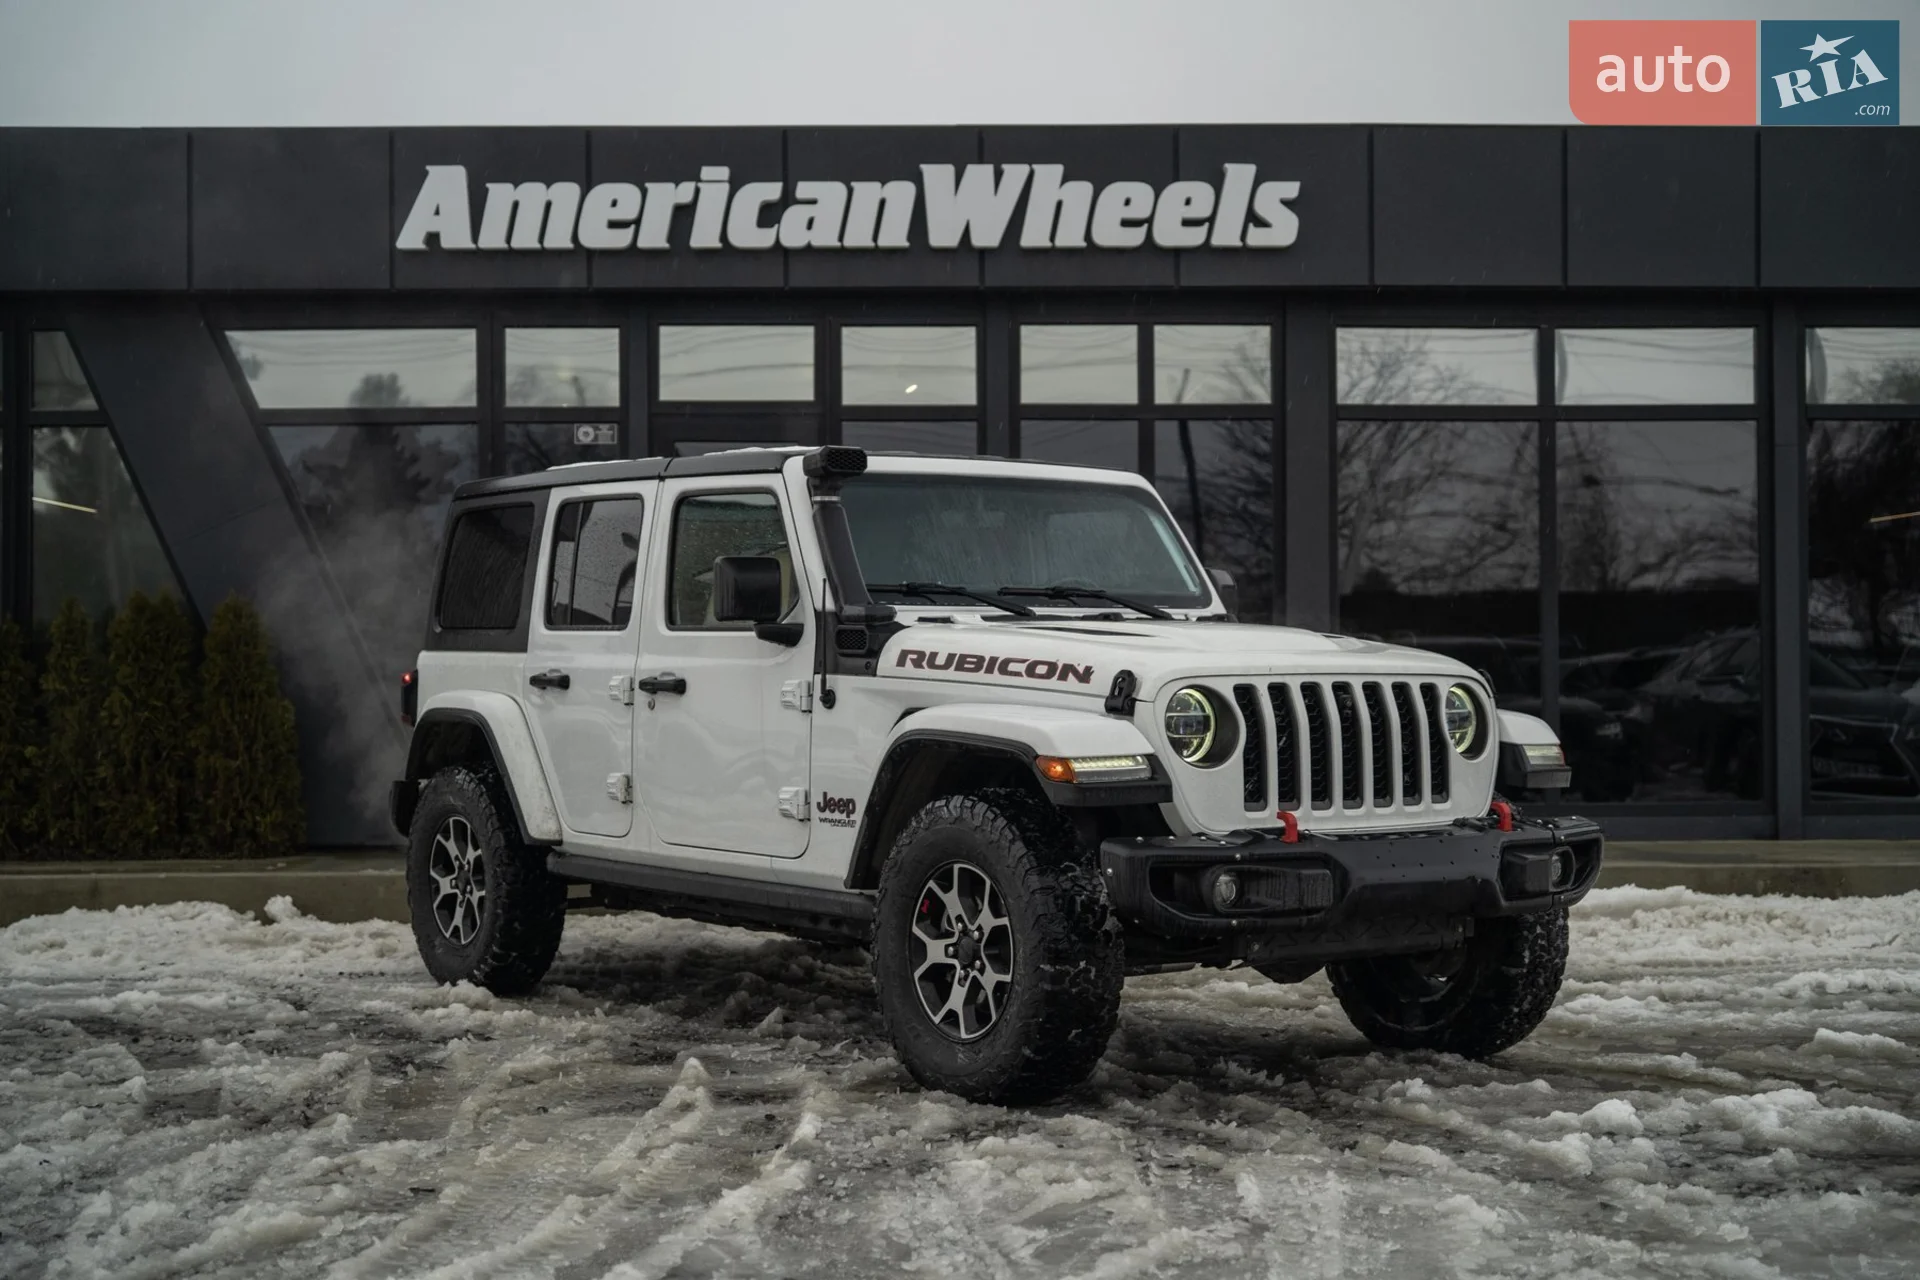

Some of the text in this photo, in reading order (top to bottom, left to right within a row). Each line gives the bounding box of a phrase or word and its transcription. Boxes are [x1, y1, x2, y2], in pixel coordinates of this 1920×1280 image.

[396, 163, 1301, 249] AmericanWheels
[896, 649, 1094, 684] RUBICON
[817, 791, 856, 818] Jeep
